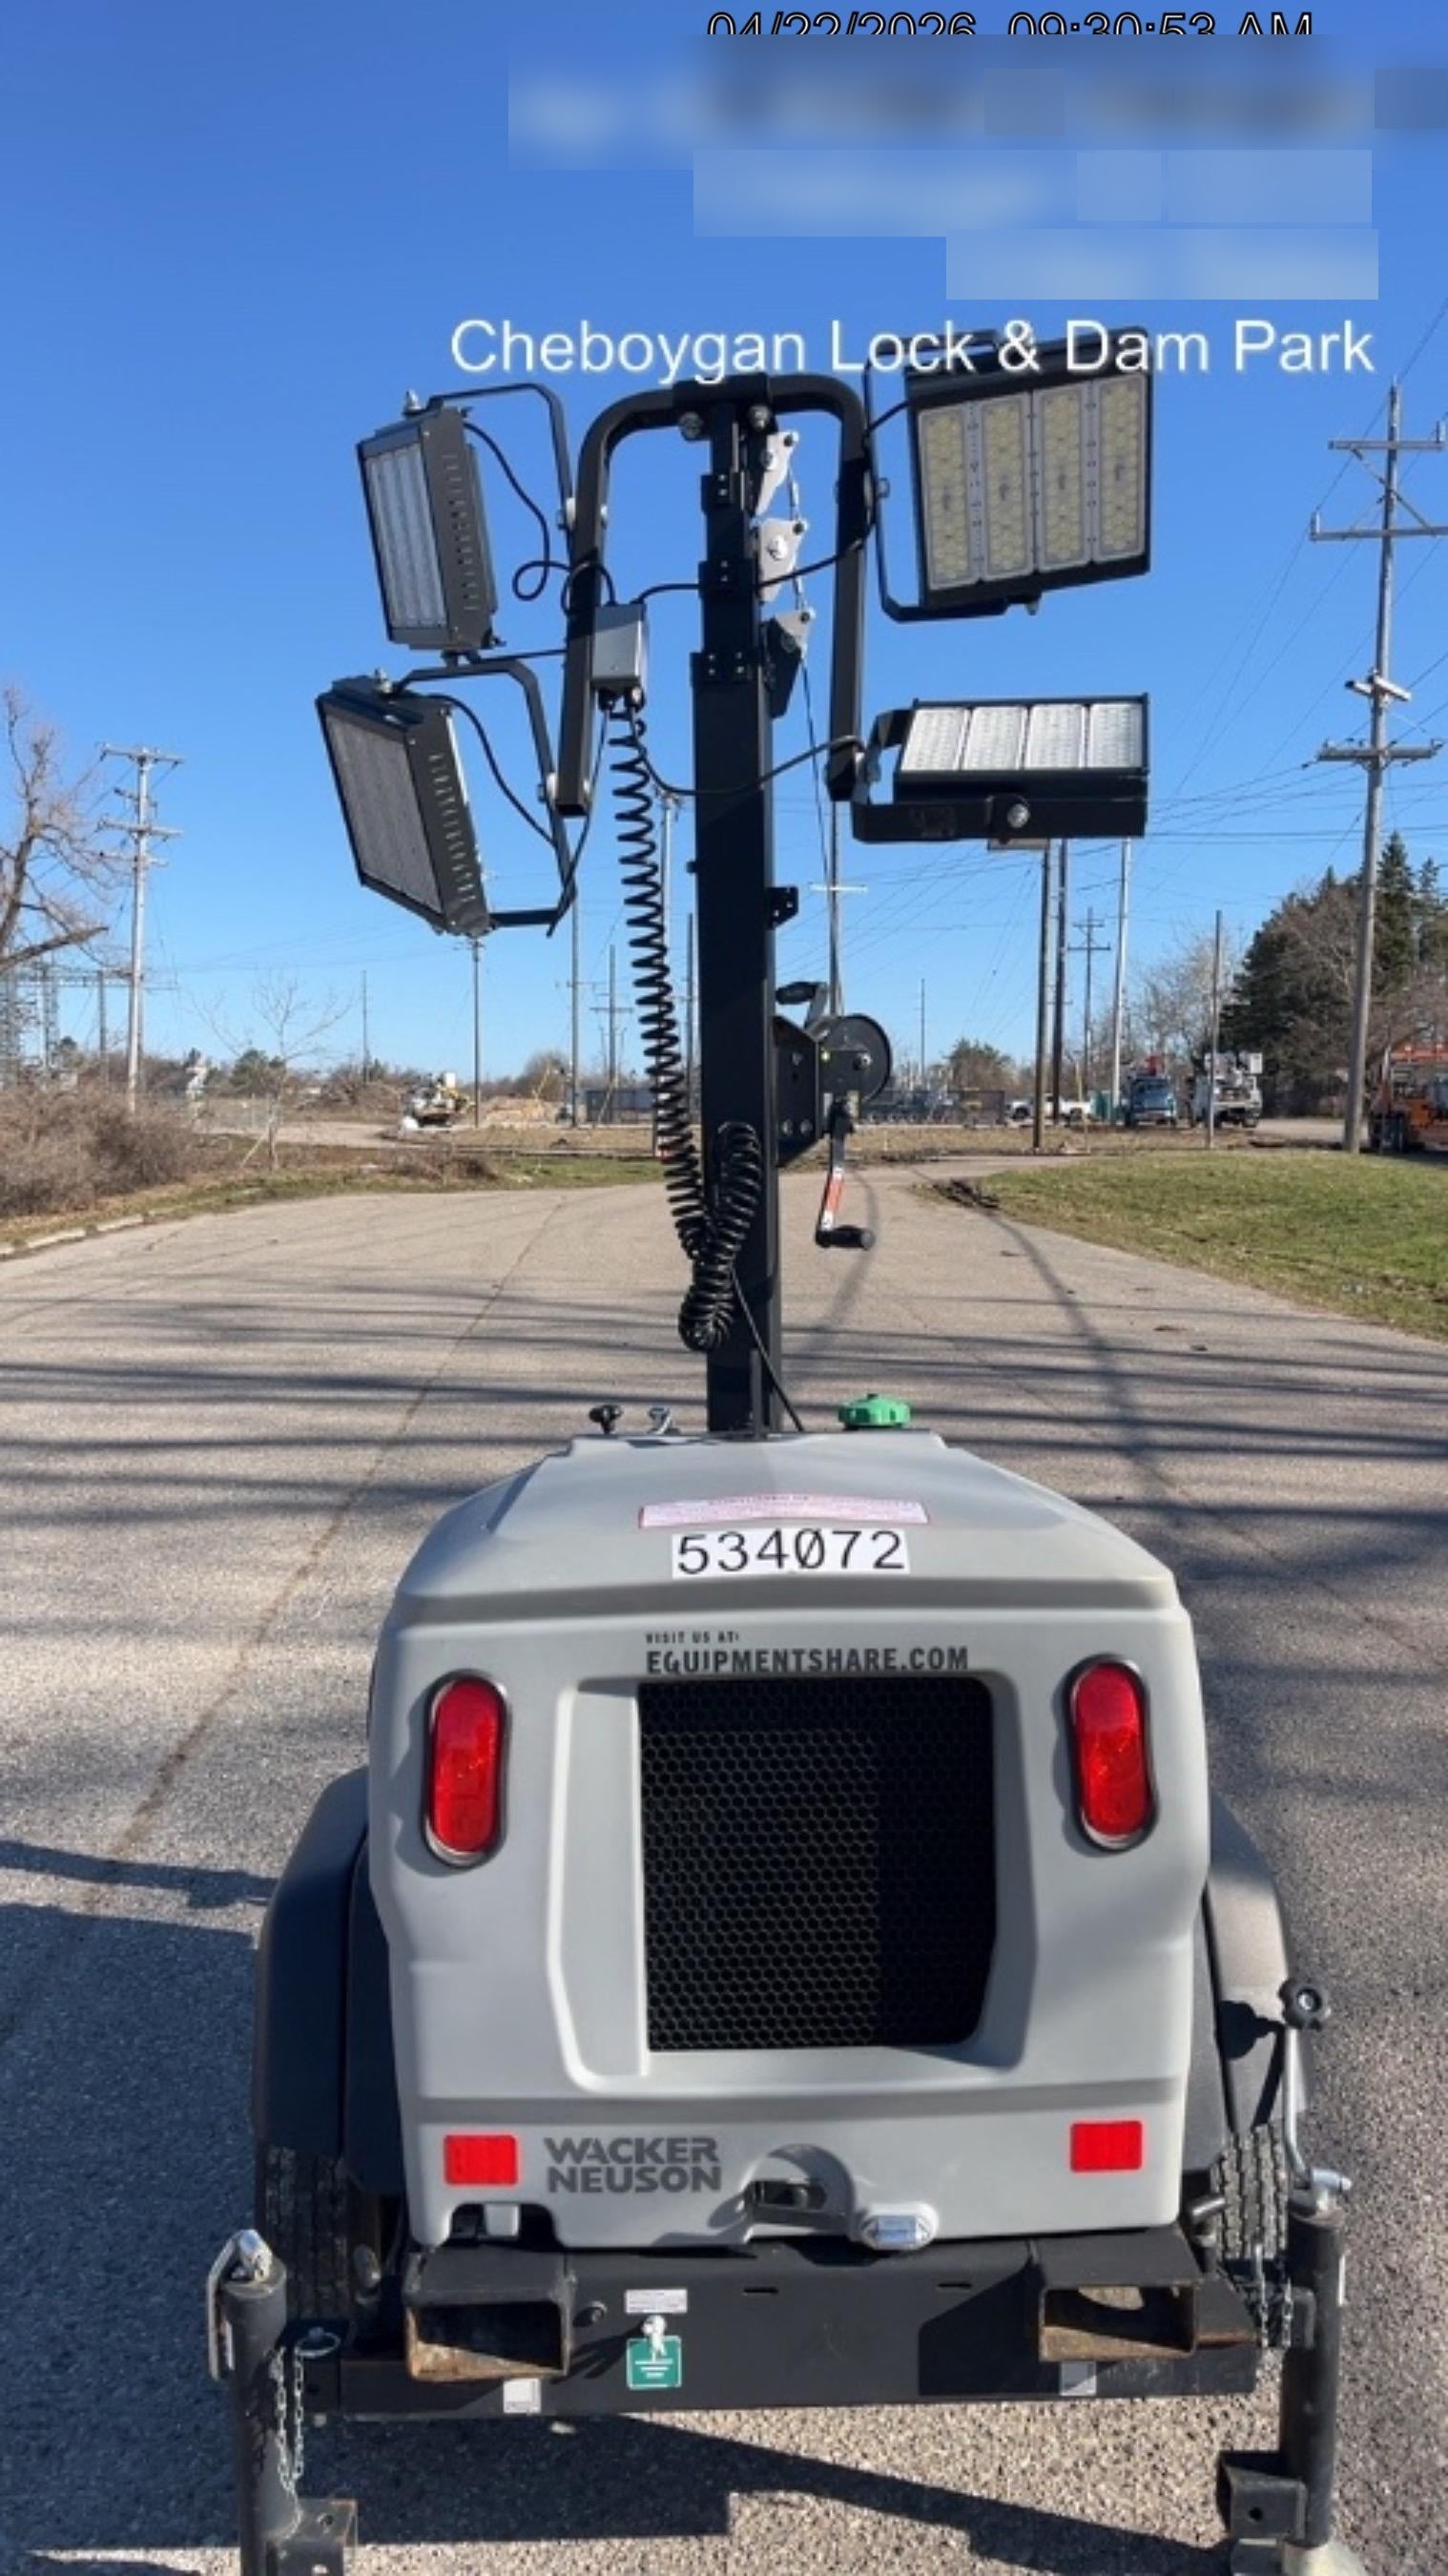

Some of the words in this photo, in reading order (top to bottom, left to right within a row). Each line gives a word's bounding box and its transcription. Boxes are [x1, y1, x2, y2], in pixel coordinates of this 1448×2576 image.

[677, 1527, 905, 1575] 534072
[646, 1631, 684, 1644] VISIT
[692, 1631, 711, 1644] US
[646, 1646, 969, 1674] EQUIPMENTSHARE.COM
[543, 2137, 719, 2165] WACKER
[548, 2166, 722, 2193] NEUSON
